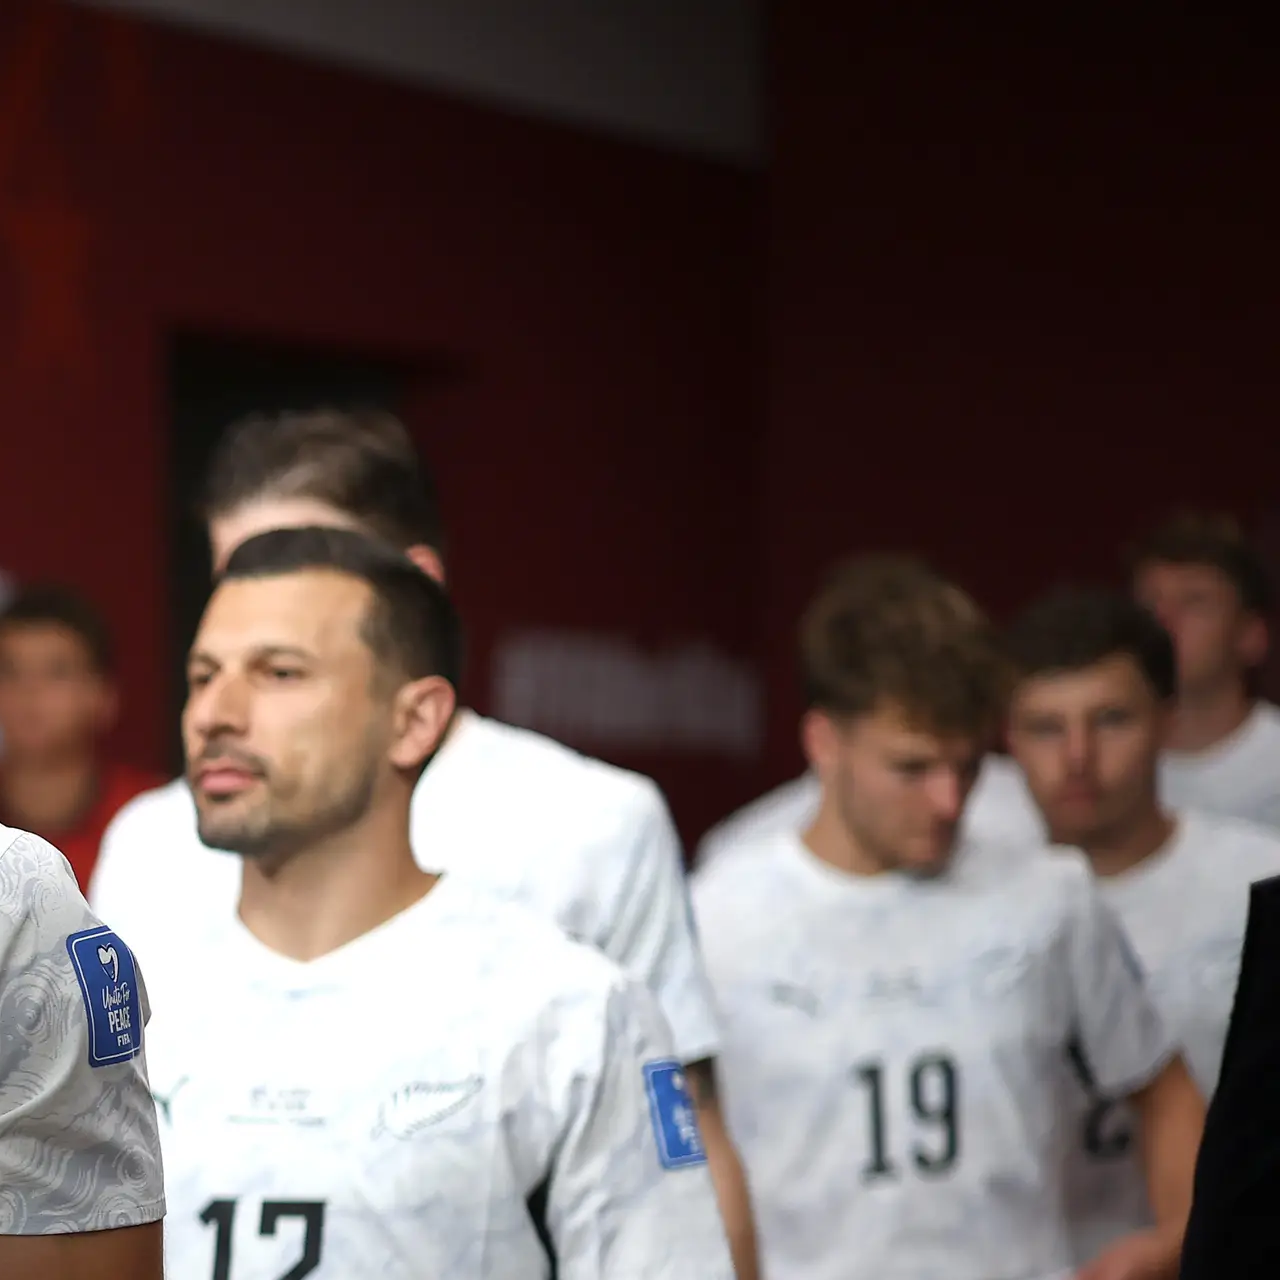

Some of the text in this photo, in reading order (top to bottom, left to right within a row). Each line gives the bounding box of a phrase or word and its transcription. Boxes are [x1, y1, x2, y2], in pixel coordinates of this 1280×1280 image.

[108, 1006, 132, 1034] PEACE
[117, 1033, 131, 1047] FIFA
[854, 1049, 961, 1184] 19
